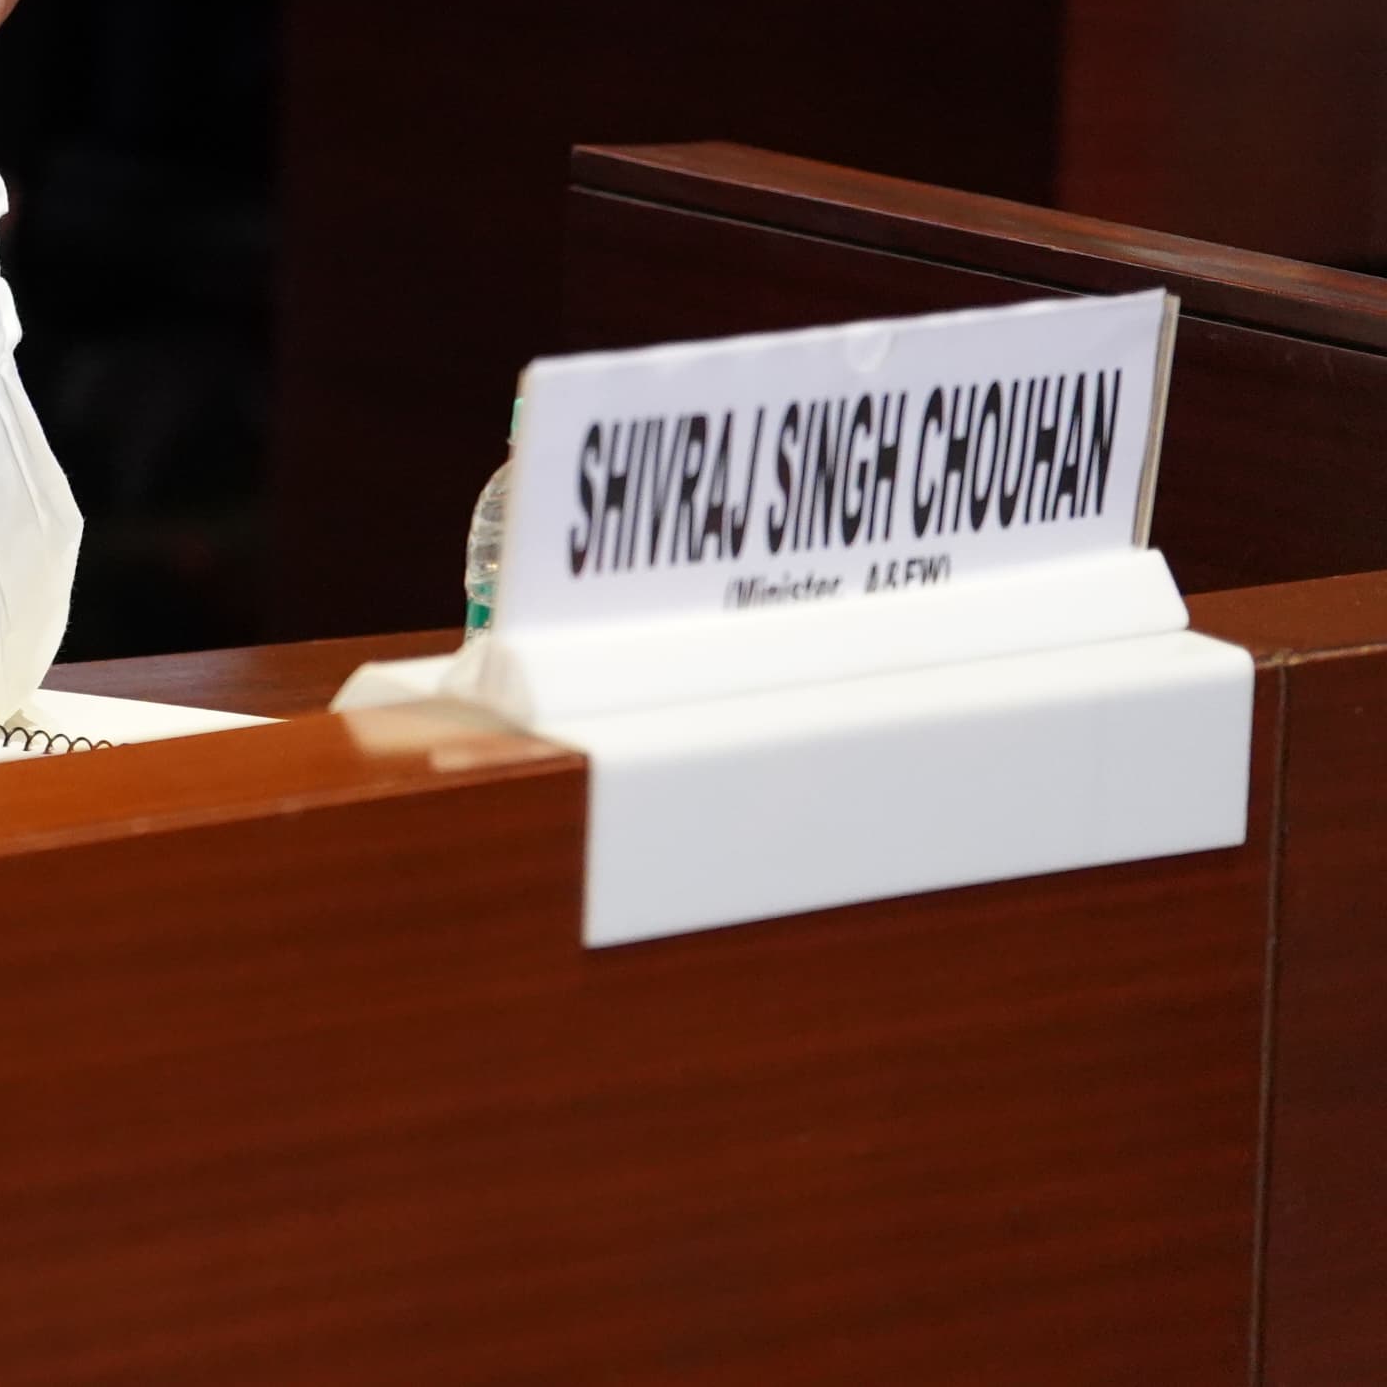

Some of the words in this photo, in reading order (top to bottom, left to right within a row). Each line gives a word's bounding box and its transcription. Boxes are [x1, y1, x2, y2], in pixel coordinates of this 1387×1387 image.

[569, 407, 765, 577] SHIVRAJ
[767, 390, 909, 555] SINGH
[912, 367, 1123, 539] CHOUHAN
